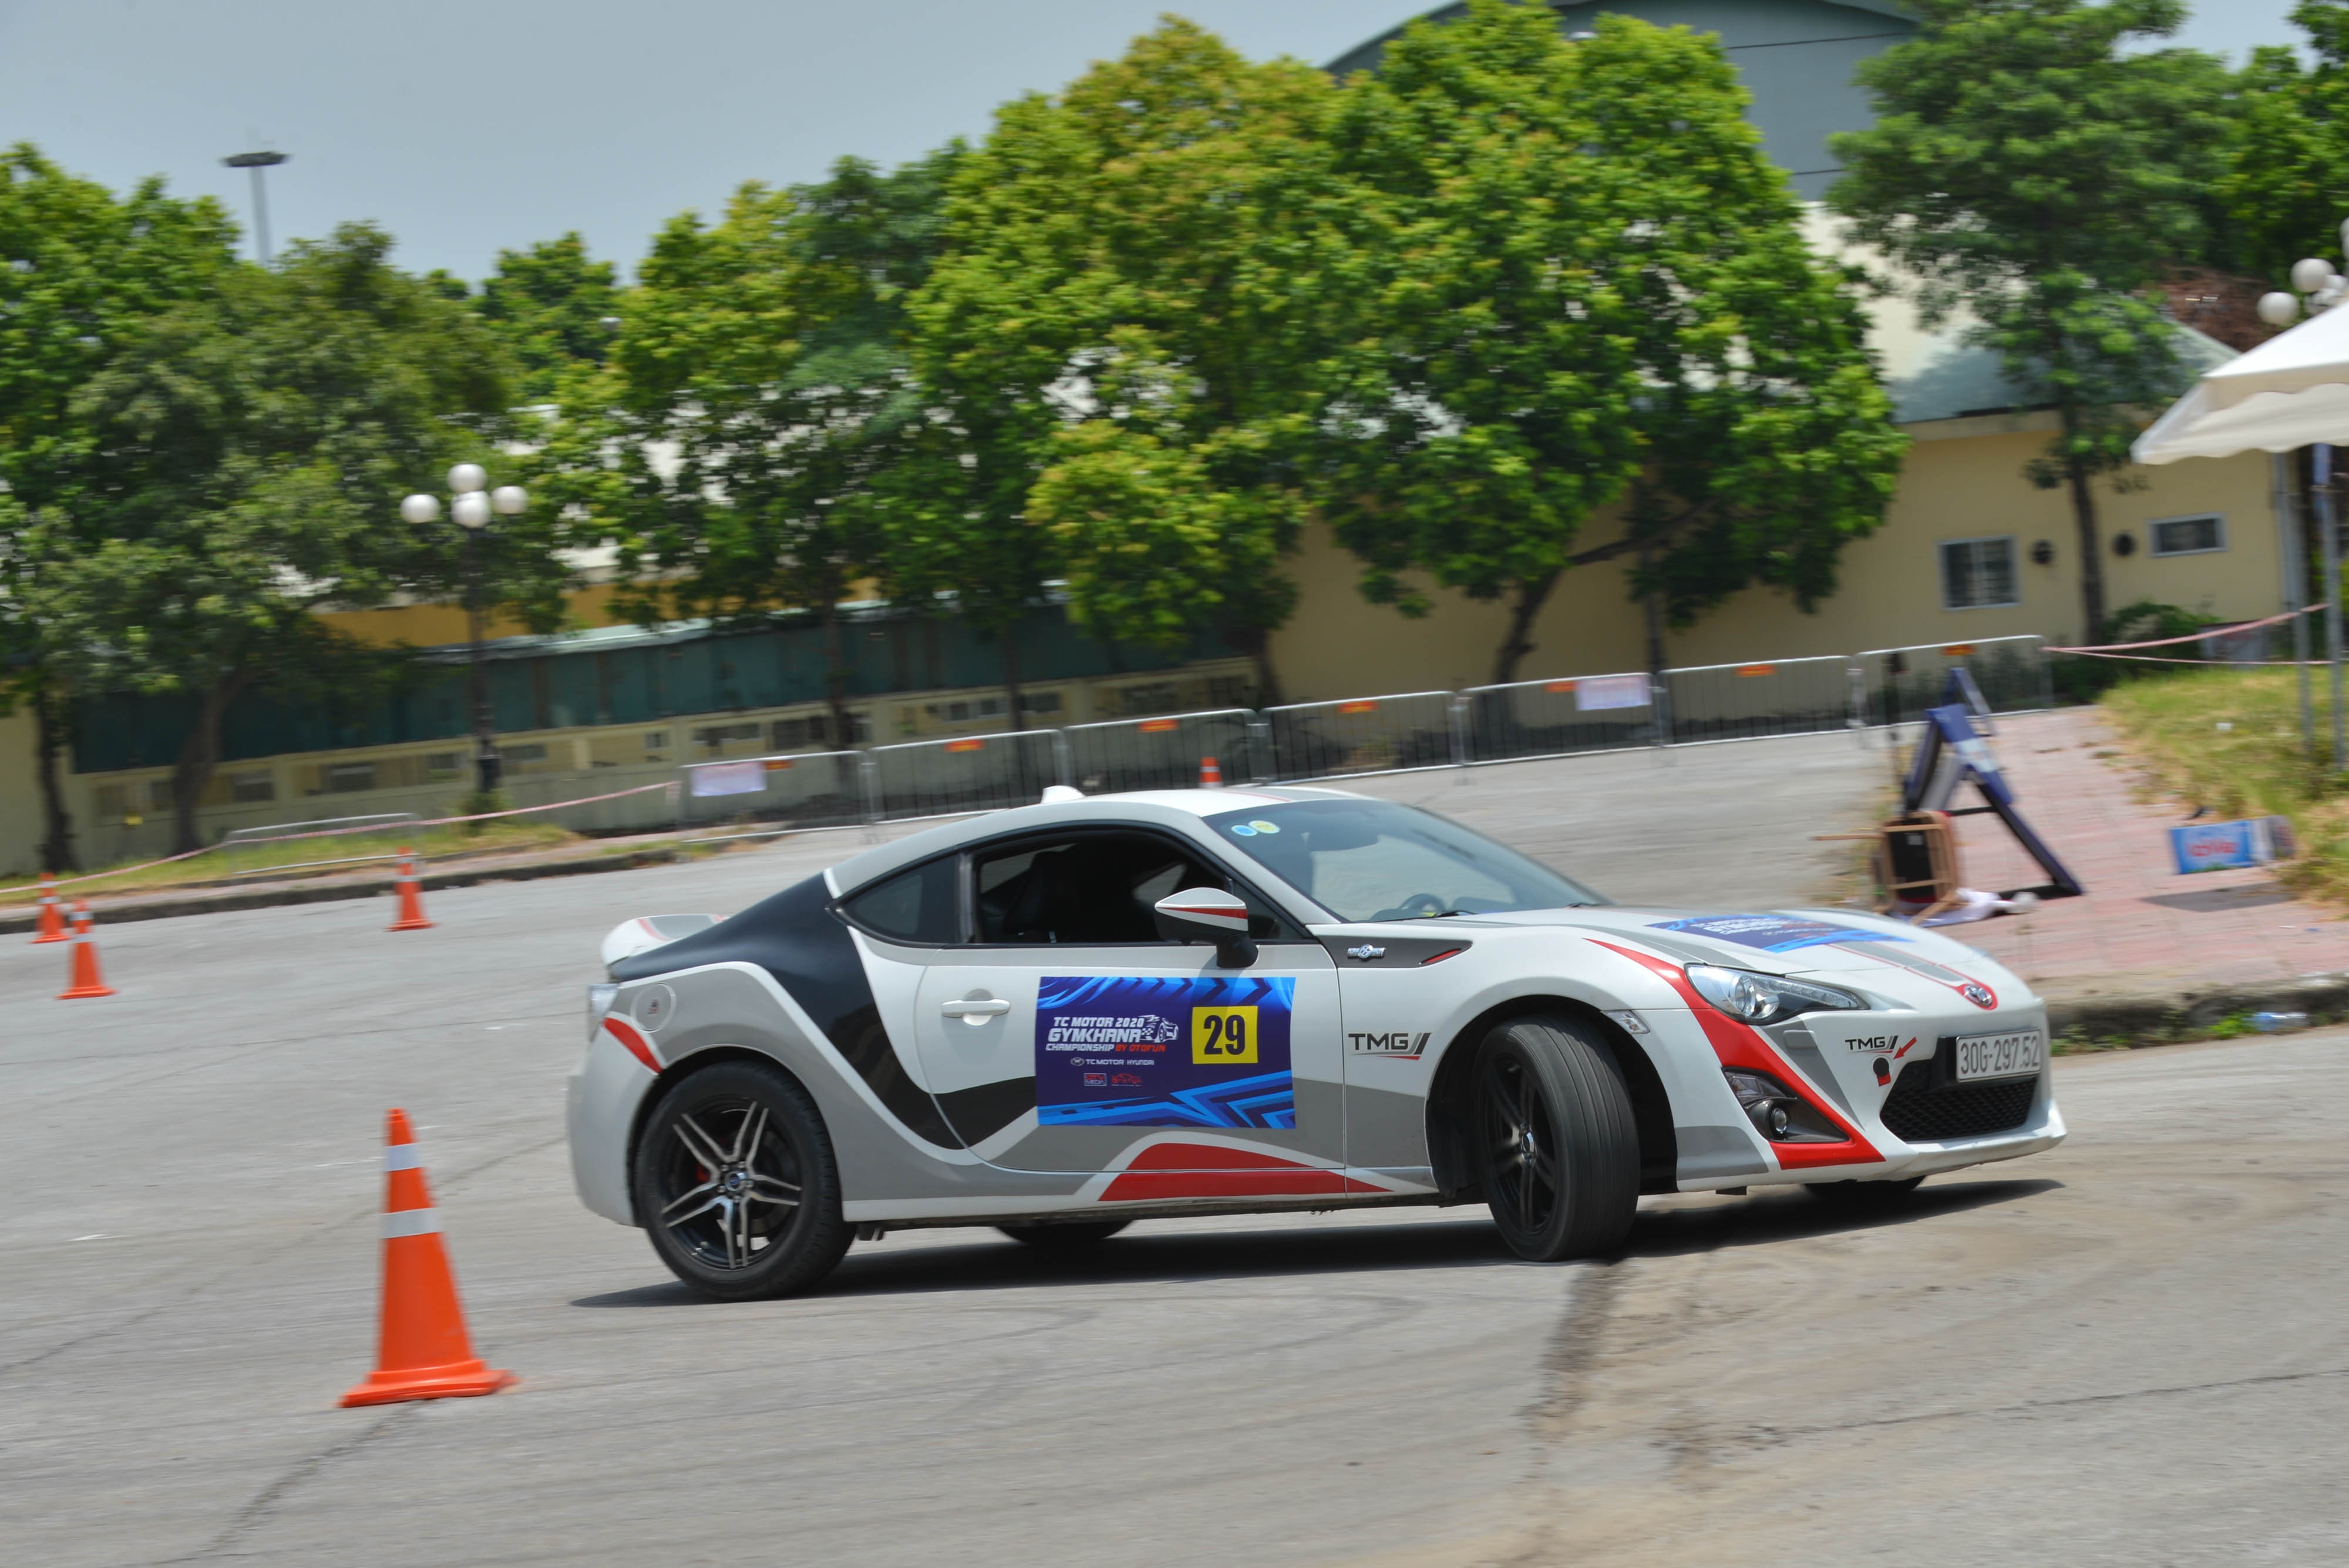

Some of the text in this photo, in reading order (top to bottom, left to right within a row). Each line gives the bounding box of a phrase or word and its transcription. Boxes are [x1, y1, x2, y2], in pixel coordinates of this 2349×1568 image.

[1054, 1017, 1145, 1028] TC MOTOR 2020
[1048, 1028, 1142, 1043] GYMKHANA
[1203, 1014, 1246, 1056] 29
[1348, 1032, 1409, 1051] TMG
[1045, 1043, 1167, 1052] CHAMPIONSHIP BY OTOFUN
[1845, 1036, 1886, 1051] TMG
[1960, 1035, 2040, 1075] 30G-297.52
